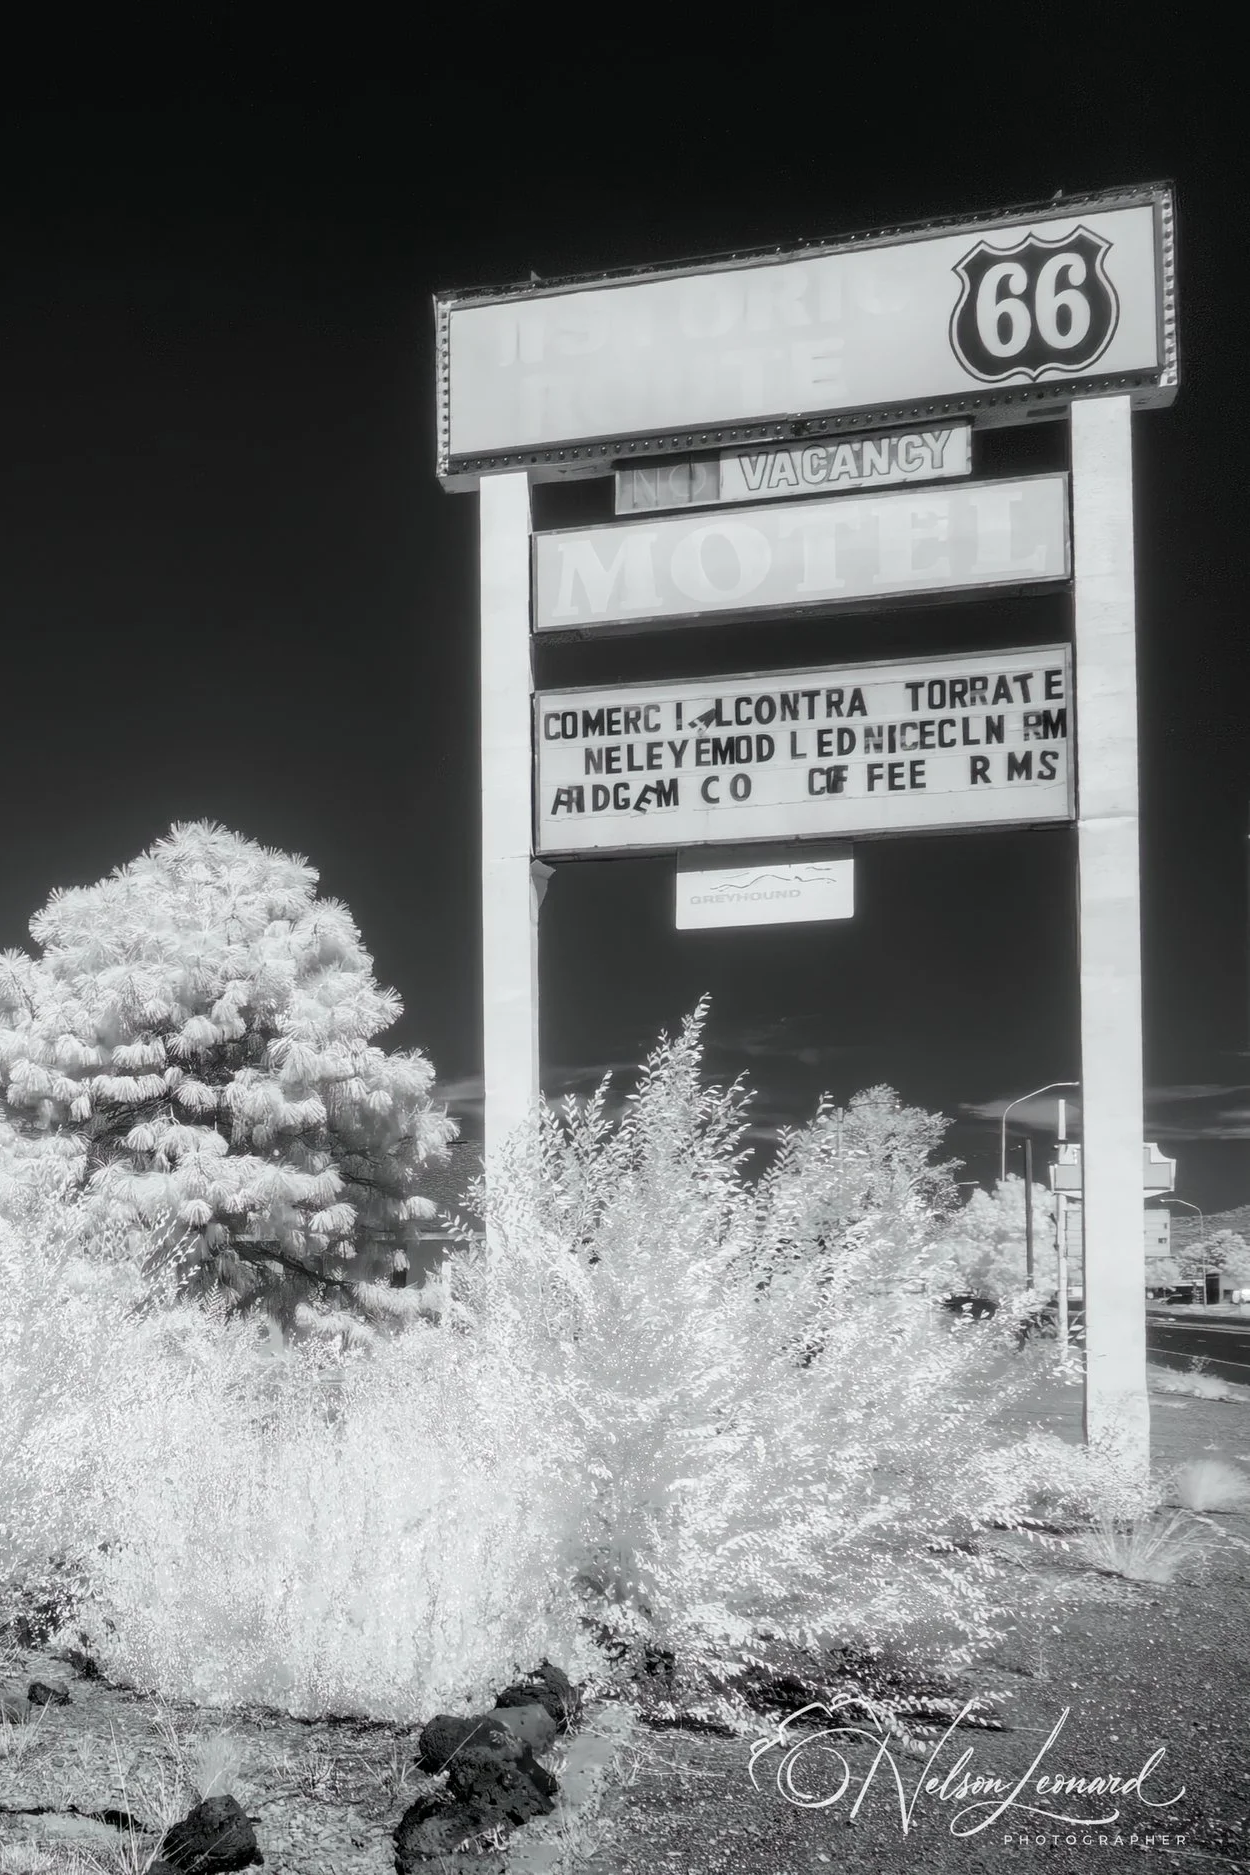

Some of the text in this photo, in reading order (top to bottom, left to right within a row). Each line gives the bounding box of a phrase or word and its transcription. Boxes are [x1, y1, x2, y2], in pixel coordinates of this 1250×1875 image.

[977, 252, 1091, 358] 66
[738, 429, 953, 491] VACANCY
[551, 491, 1047, 617] MOTEL
[690, 889, 802, 905] GREYHOUND
